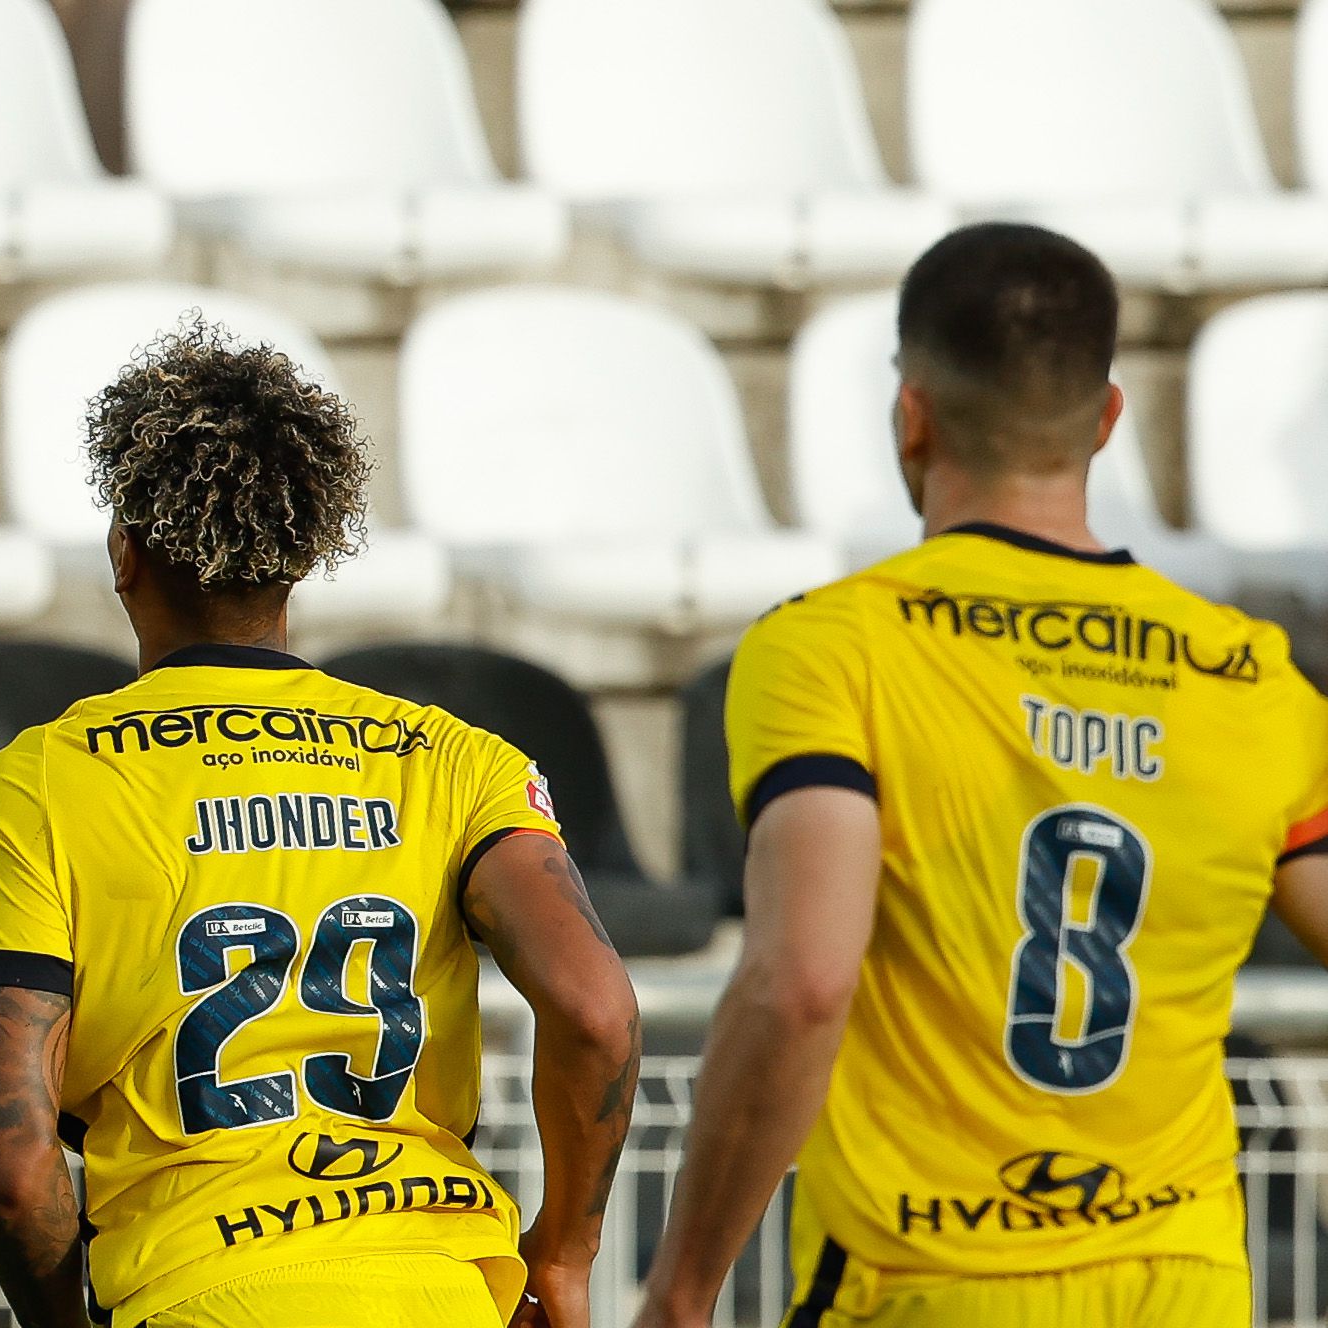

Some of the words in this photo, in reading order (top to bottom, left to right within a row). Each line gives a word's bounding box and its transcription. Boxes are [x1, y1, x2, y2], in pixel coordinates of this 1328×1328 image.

[201, 752, 244, 770] aço
[252, 746, 361, 773] inoxidável
[1019, 693, 1164, 783] TOPIC
[186, 793, 401, 854] JHONDER
[1003, 803, 1153, 1097] 8
[175, 893, 427, 1136] 29
[214, 1175, 495, 1248] HYUNDAI
